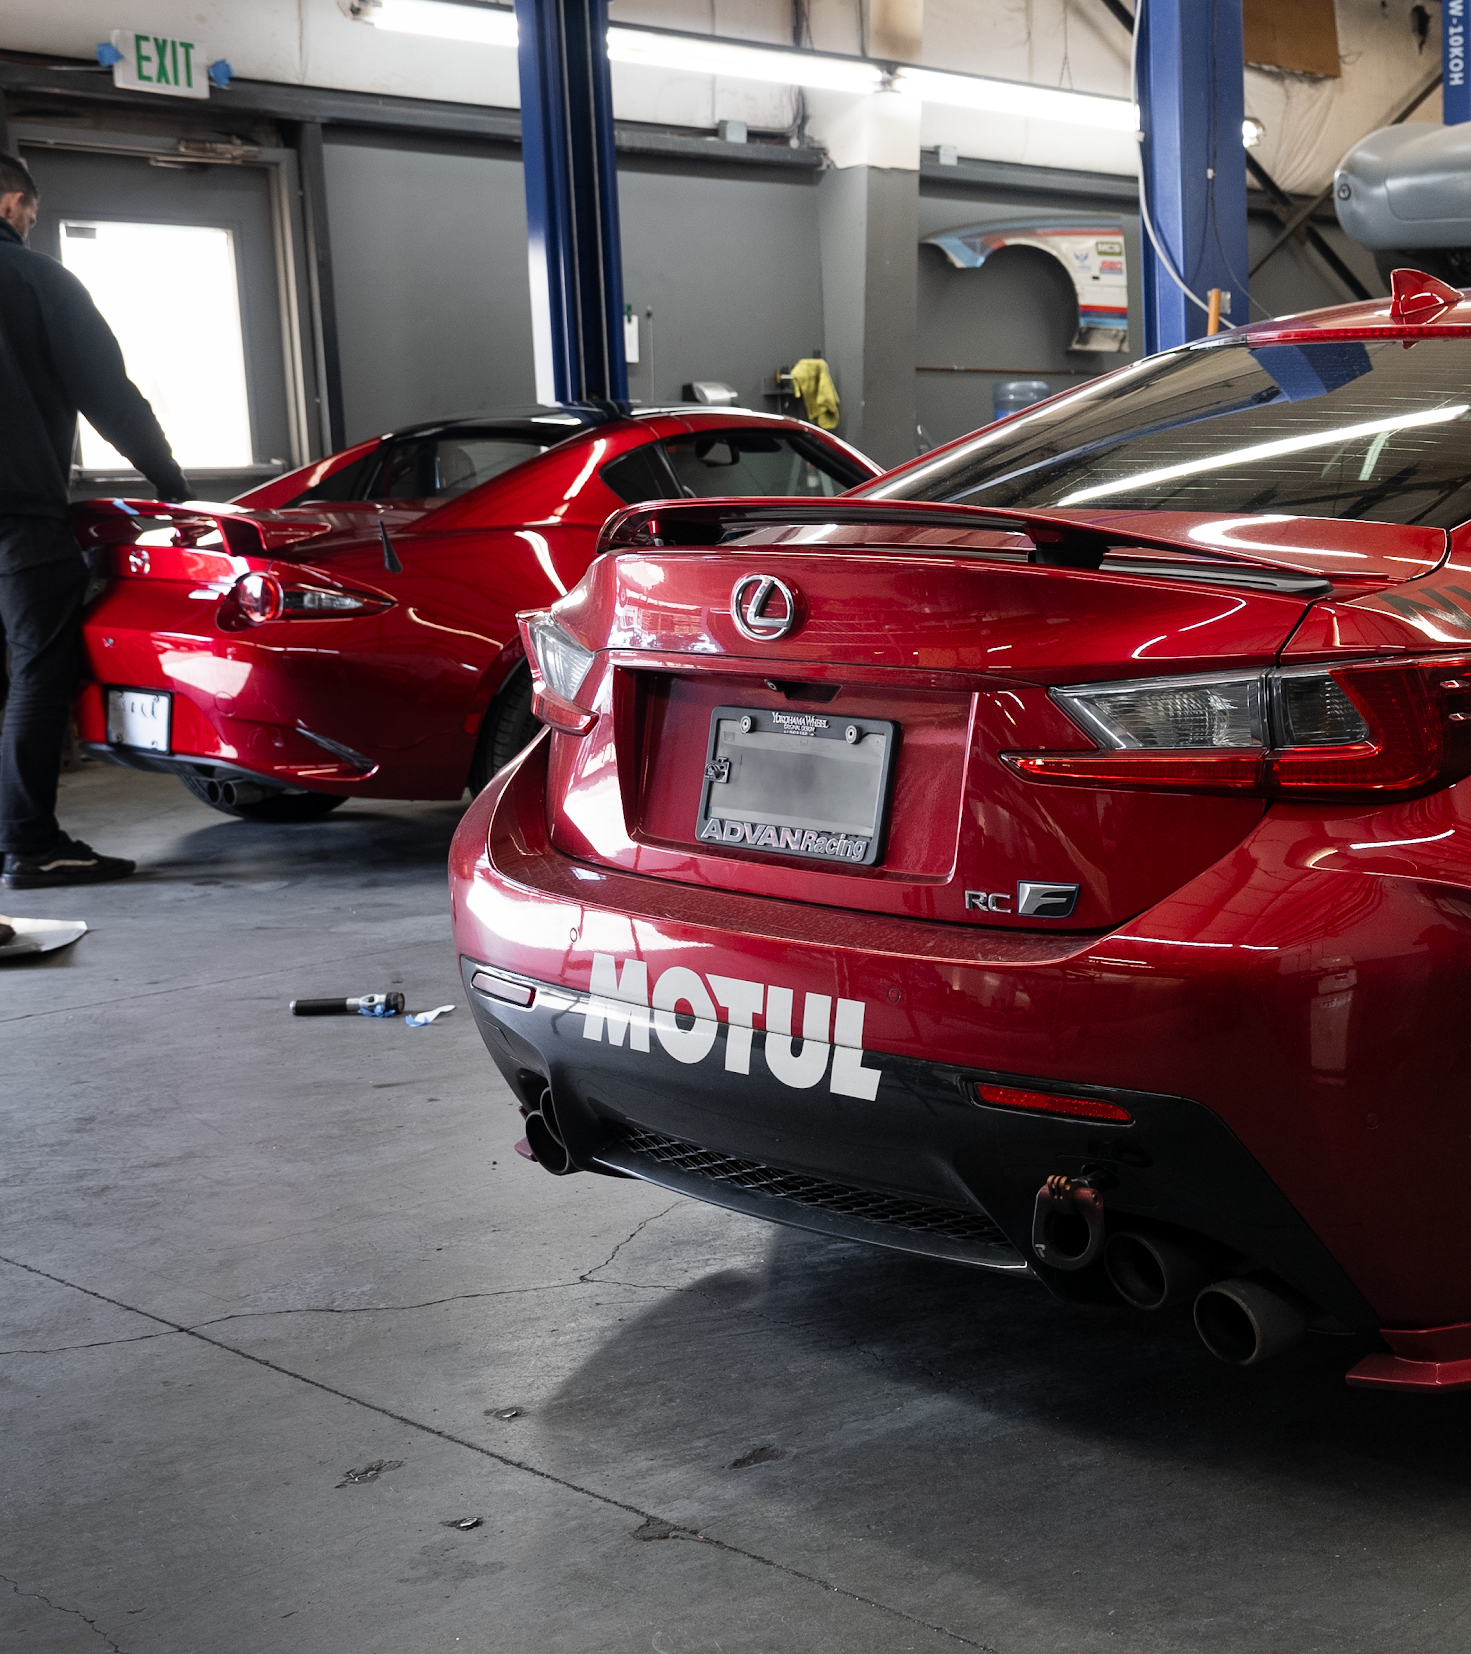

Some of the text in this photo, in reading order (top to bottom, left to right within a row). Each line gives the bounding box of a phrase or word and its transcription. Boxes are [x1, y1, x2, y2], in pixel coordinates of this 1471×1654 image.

[135, 34, 195, 88] EXIT
[965, 889, 1012, 914] RC
[582, 951, 882, 1102] MOTUL
